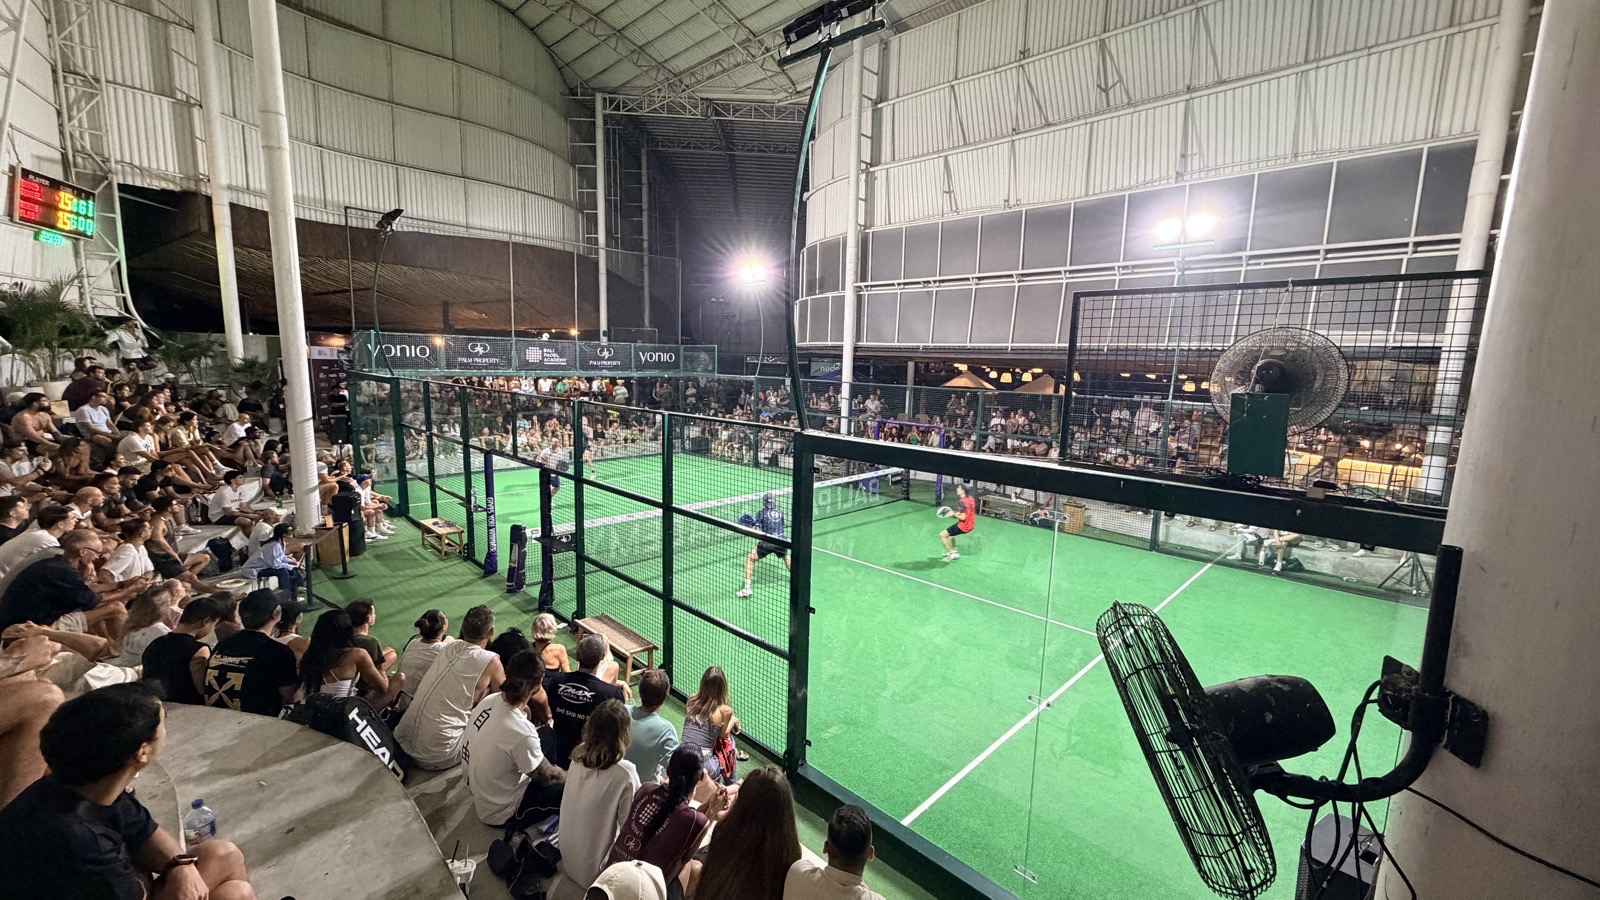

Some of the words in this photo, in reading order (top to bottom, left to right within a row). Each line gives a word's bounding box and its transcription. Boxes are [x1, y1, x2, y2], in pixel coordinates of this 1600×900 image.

[28, 174, 50, 187] PLAYER
[639, 351, 676, 364] yonio
[565, 709, 577, 718] SAID
[348, 706, 405, 782] HEAD
[631, 795, 649, 820] ACADEMY
